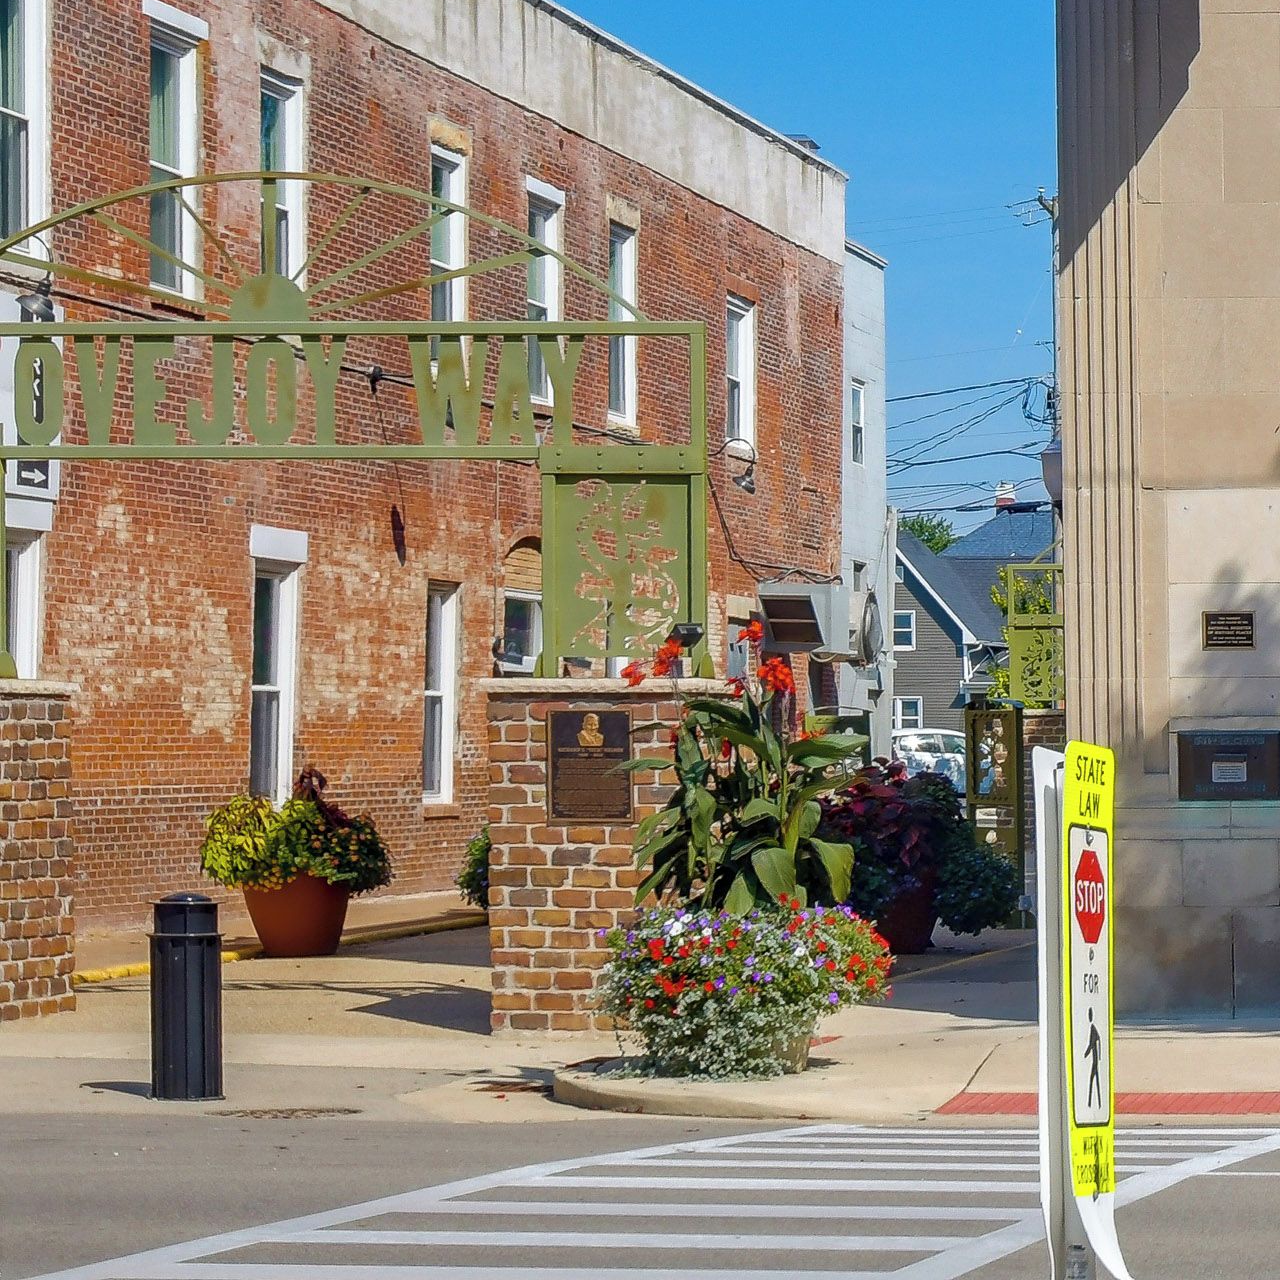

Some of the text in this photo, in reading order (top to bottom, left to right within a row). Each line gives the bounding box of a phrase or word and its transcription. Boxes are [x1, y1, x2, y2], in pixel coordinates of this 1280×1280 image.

[0, 335, 348, 446] OVEJOY
[407, 335, 586, 446] WAY
[1075, 754, 1106, 786] STATE
[1079, 790, 1101, 819] LAW
[1076, 879, 1104, 915] STOP
[1083, 973, 1099, 994] FOR
